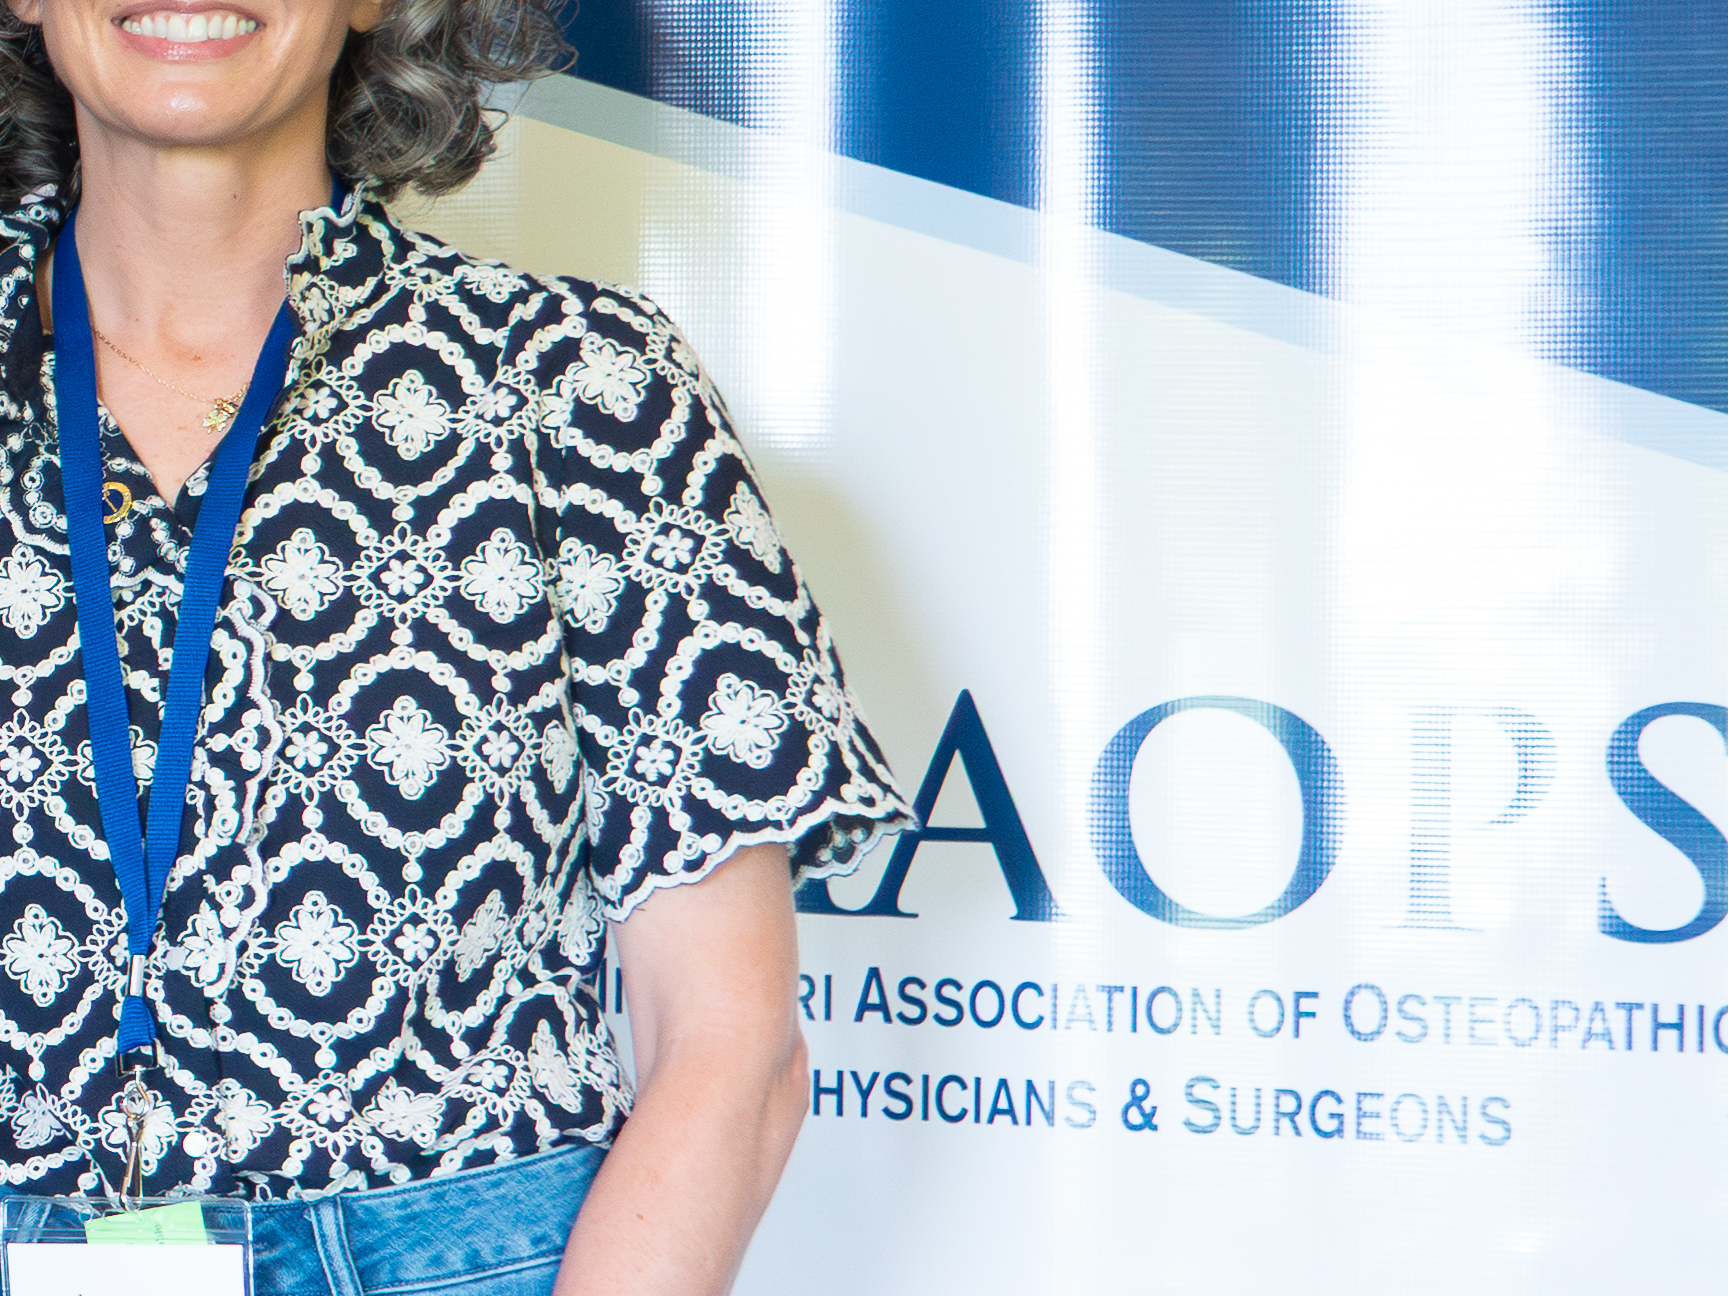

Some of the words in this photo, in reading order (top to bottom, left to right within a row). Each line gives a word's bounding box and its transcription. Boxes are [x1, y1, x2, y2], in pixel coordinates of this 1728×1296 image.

[795, 687, 1728, 945] AOPS
[1248, 990, 1319, 1040] OF
[812, 1068, 1098, 1129] HYSICIANS
[1120, 1078, 1160, 1133] &
